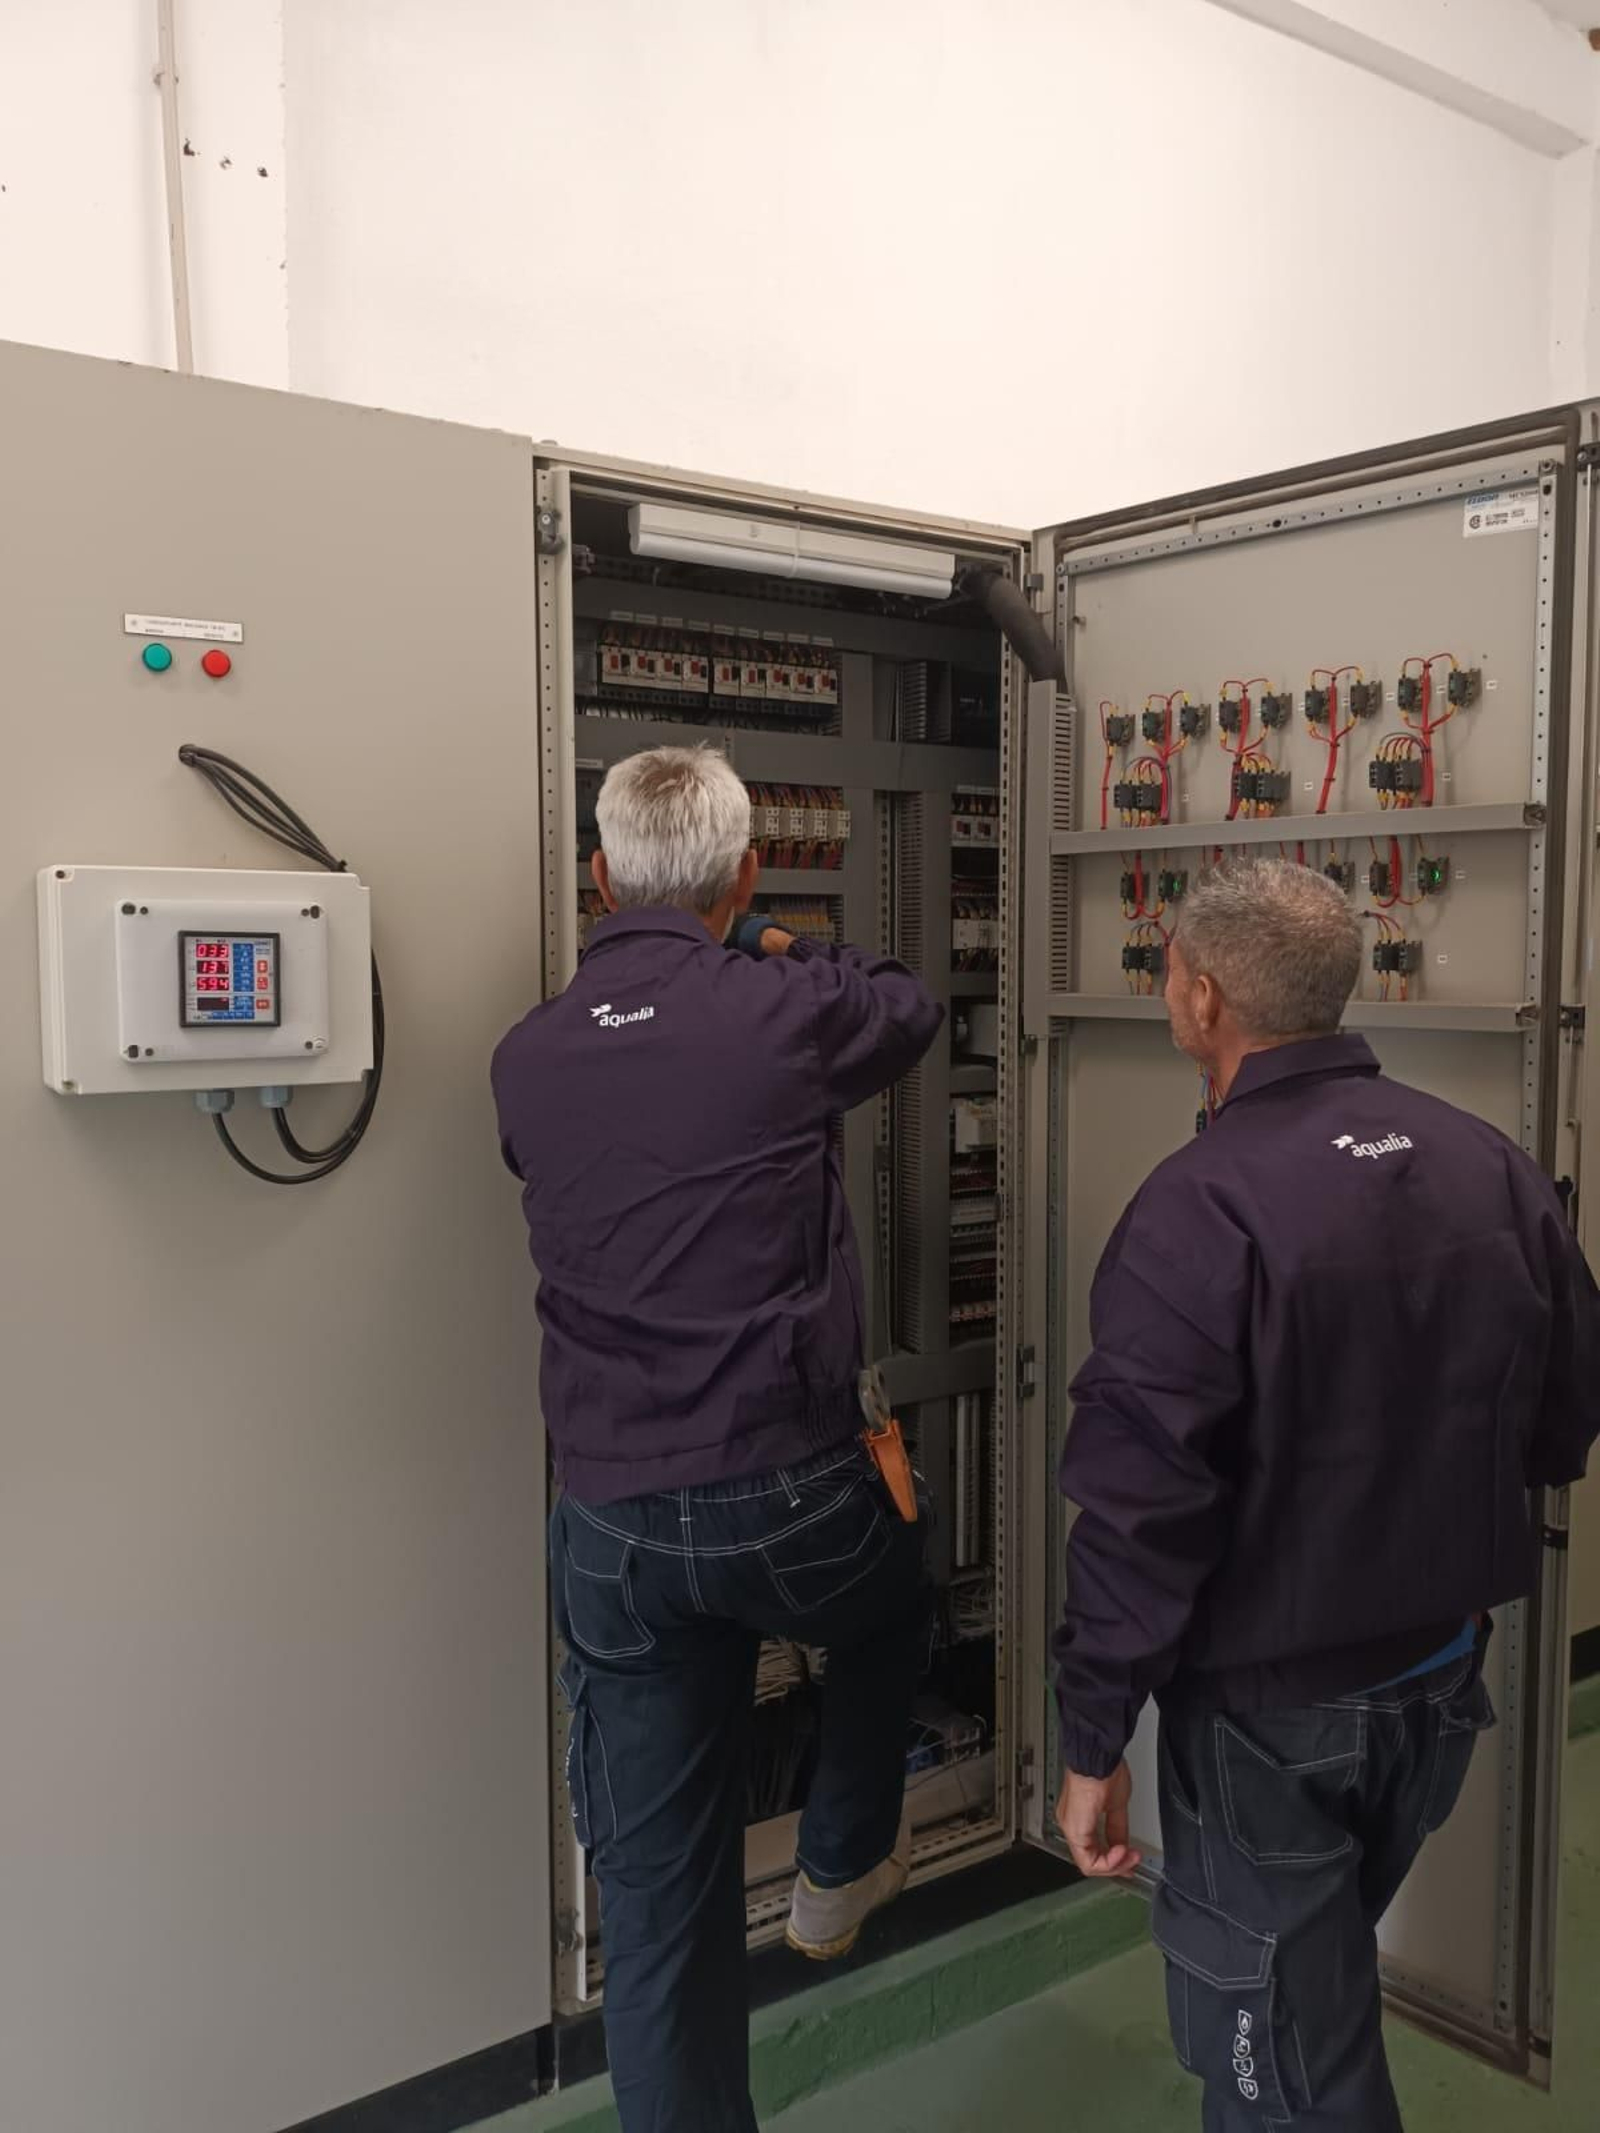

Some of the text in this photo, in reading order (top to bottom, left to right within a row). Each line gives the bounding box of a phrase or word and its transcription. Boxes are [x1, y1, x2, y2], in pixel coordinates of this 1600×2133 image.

[202, 961, 228, 975] 137
[198, 978, 228, 991] 594
[599, 1006, 655, 1029] aqualia
[1350, 1132, 1413, 1160] aqualia
